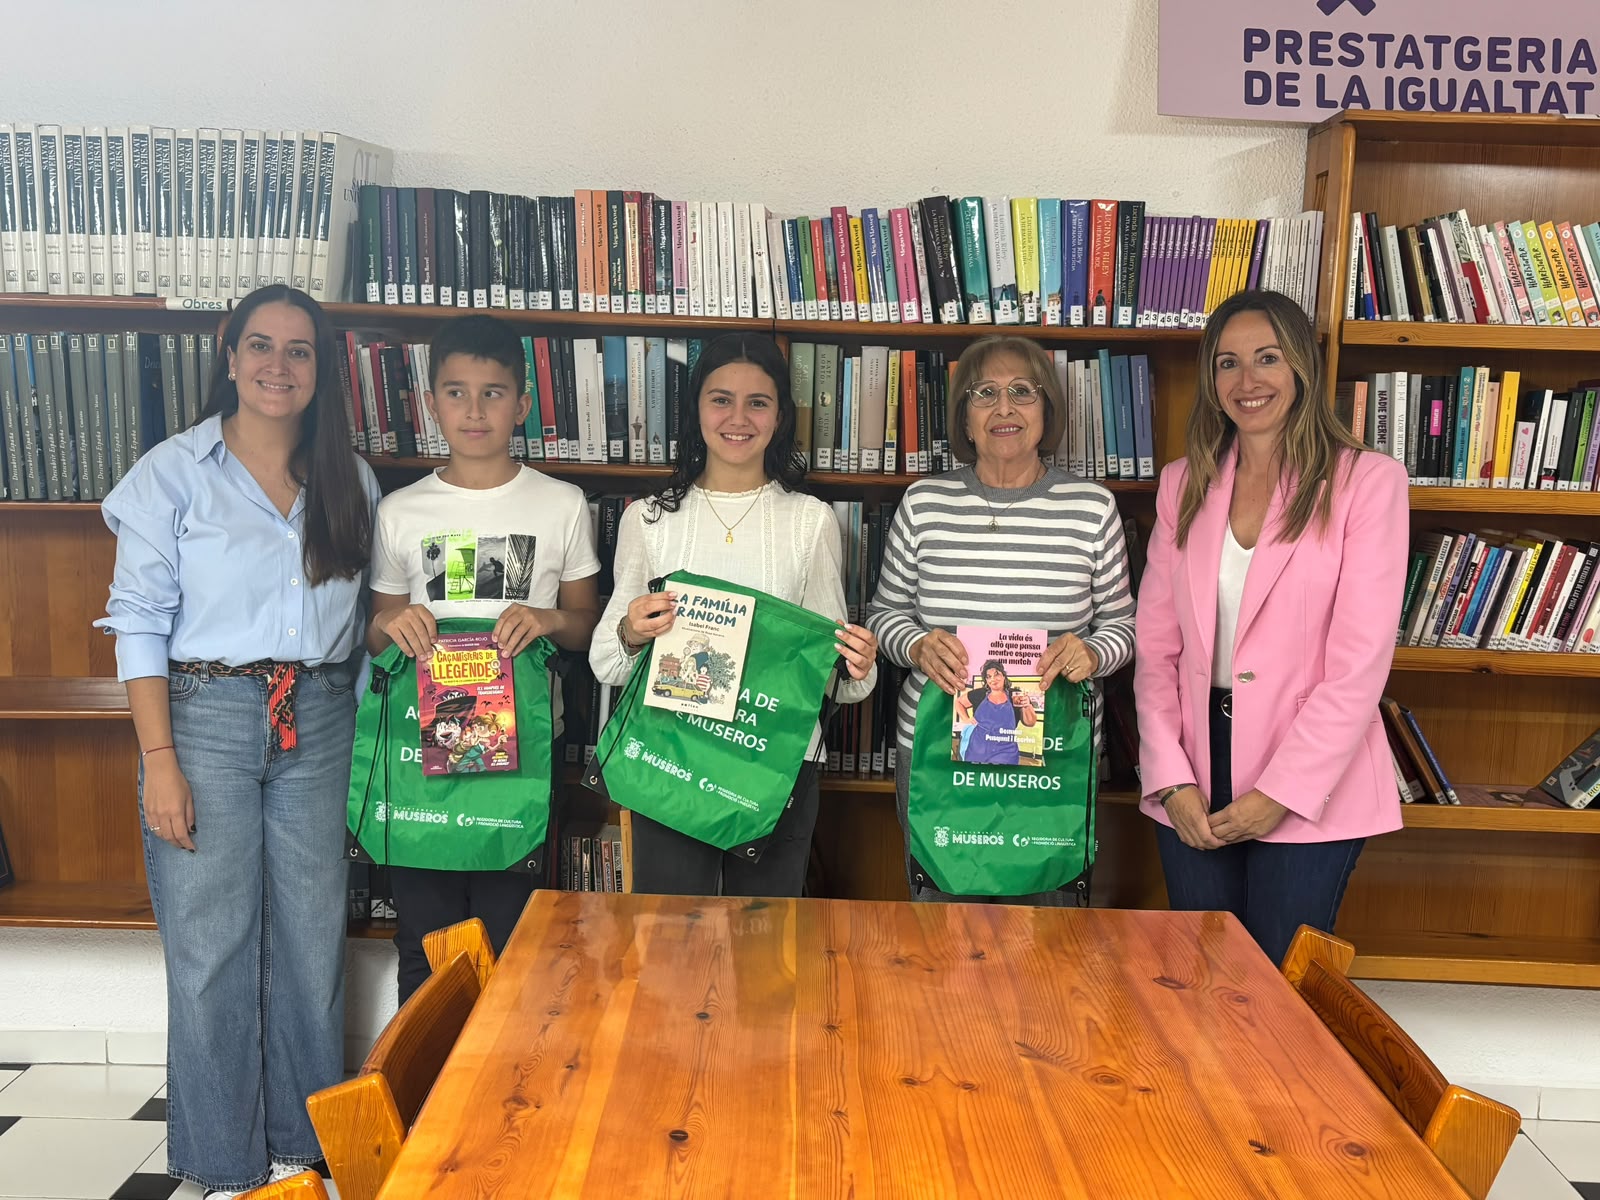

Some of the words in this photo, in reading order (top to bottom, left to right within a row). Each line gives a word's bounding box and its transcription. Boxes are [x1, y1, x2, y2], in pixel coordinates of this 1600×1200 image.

[1243, 28, 1598, 75] PRESTATGERIA
[1244, 70, 1301, 107] DE
[1316, 73, 1371, 110] LA
[1385, 75, 1595, 114] IGUALTAT
[16, 136, 25, 168] SALVAT
[24, 135, 33, 186] UNIVERSAL
[41, 139, 49, 171] SALVAT
[48, 138, 57, 188] UNIVERSAL
[65, 138, 74, 170] SALVAT
[72, 137, 82, 188] UNIVERSAL
[86, 139, 95, 171] SALVAT
[93, 139, 102, 189] UNIVERSAL
[108, 139, 117, 171] SALVAT
[115, 139, 124, 189] UNIVERSAL
[132, 137, 141, 168] SALVAT
[139, 136, 148, 187] UNIVERSAL
[155, 141, 163, 173] SALVAT
[161, 141, 171, 192] UNIVERSAL
[177, 141, 185, 173] SALVAT
[184, 140, 193, 191] UNIVERSAL
[206, 143, 215, 192] UNIVERSAL
[221, 143, 229, 174] SALVAT
[227, 143, 236, 192] UNIVERSAL
[249, 142, 258, 192] UNIVERSAL
[269, 142, 279, 192] UNIVERSAL
[281, 143, 290, 174] SALVAT
[285, 143, 295, 192] UNIVERSAL
[302, 143, 310, 174] SALVAT
[306, 143, 317, 192] UNIVERSAL
[320, 145, 328, 177] SALVAT
[324, 145, 335, 195] UNIVERSAL
[938, 216, 948, 242] Lucinda
[1103, 212, 1112, 248] LUCINDA
[1130, 232, 1138, 248] Riley
[1102, 252, 1110, 276] RILEY
[1128, 252, 1136, 270] Harry
[1504, 246, 1522, 288] HEARTSTOPPER
[1518, 248, 1537, 288] HEARTSTOPPER
[1533, 248, 1552, 288] HEARTSTOPPER
[1550, 248, 1570, 289] HEARTSTOPPER
[1568, 248, 1587, 288] HEARTSTOPPER
[182, 298, 222, 310] Obres
[1126, 272, 1135, 304] Whittaker
[1378, 390, 1388, 412] NADIE
[1377, 415, 1387, 444] DUERME
[677, 606, 736, 628] RANDOM
[692, 598, 747, 617] FAMÍLIA
[1005, 643, 1018, 651] que
[1020, 643, 1041, 651] passa
[432, 662, 500, 680] LLEGENDES
[755, 692, 780, 712] DE
[687, 711, 768, 751] MUSEROS
[1043, 737, 1063, 751] DE
[400, 746, 422, 762] DE
[641, 751, 692, 781] MUSEROS
[953, 771, 975, 786] DE
[979, 772, 1061, 790] MUSEROS
[394, 810, 448, 824] MUSEROS
[952, 833, 1004, 845] MUSEROS
